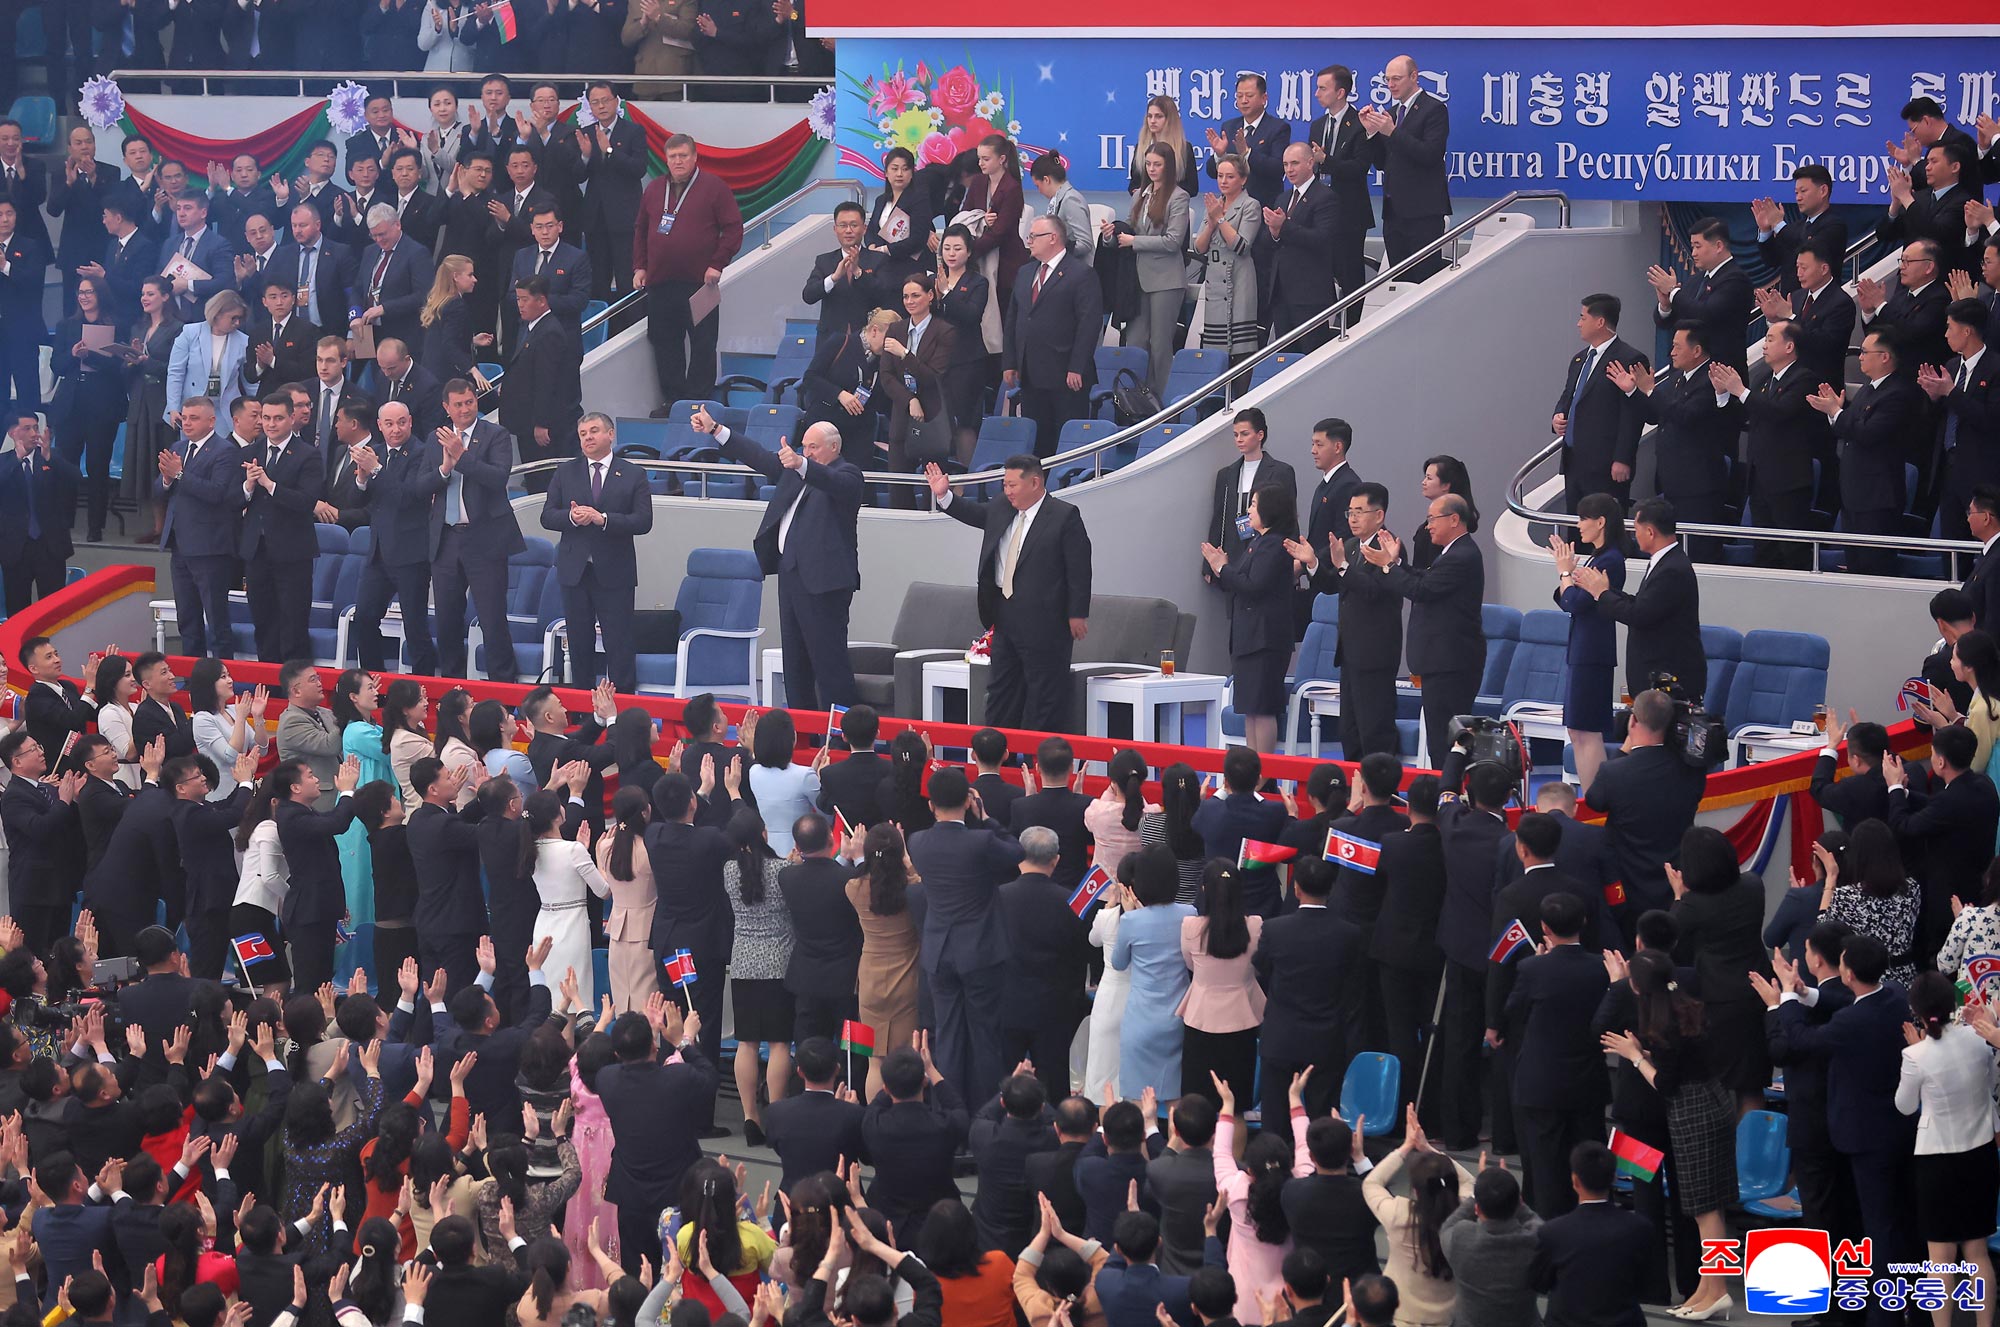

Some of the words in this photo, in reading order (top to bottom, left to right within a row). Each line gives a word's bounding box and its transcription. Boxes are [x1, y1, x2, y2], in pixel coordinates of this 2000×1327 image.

[1480, 70, 1611, 127] 대통령
[1645, 71, 1872, 128] 알렉싼드르
[1555, 141, 1761, 191] Республики
